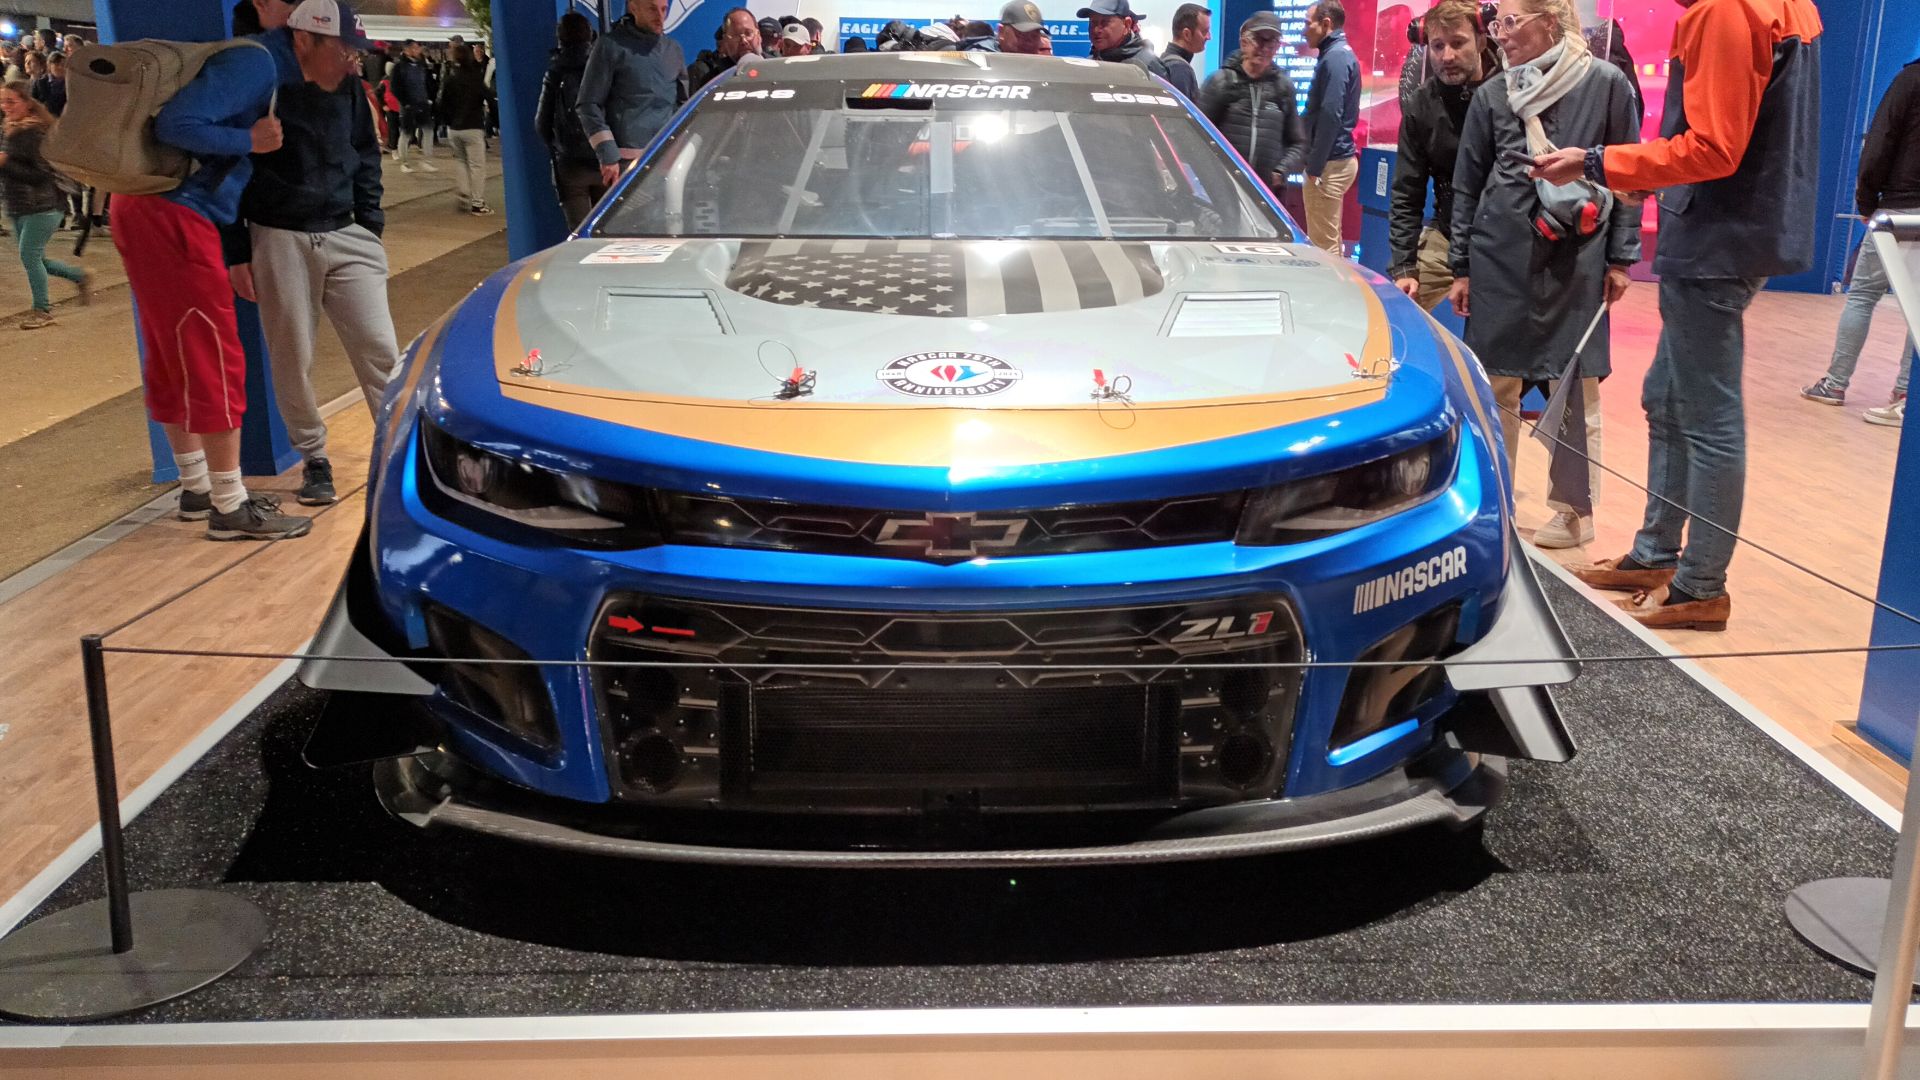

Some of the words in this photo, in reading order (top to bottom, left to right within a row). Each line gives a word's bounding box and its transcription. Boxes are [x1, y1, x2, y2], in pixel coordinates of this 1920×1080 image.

[713, 89, 796, 101] 1948
[904, 83, 1031, 99] NASCAR
[897, 352, 957, 367] NASCAR
[963, 352, 1002, 367] 75TH
[893, 379, 1007, 396] ANNIVERSARY
[1385, 544, 1467, 604] NASCAR
[1170, 610, 1275, 643] ZL1
